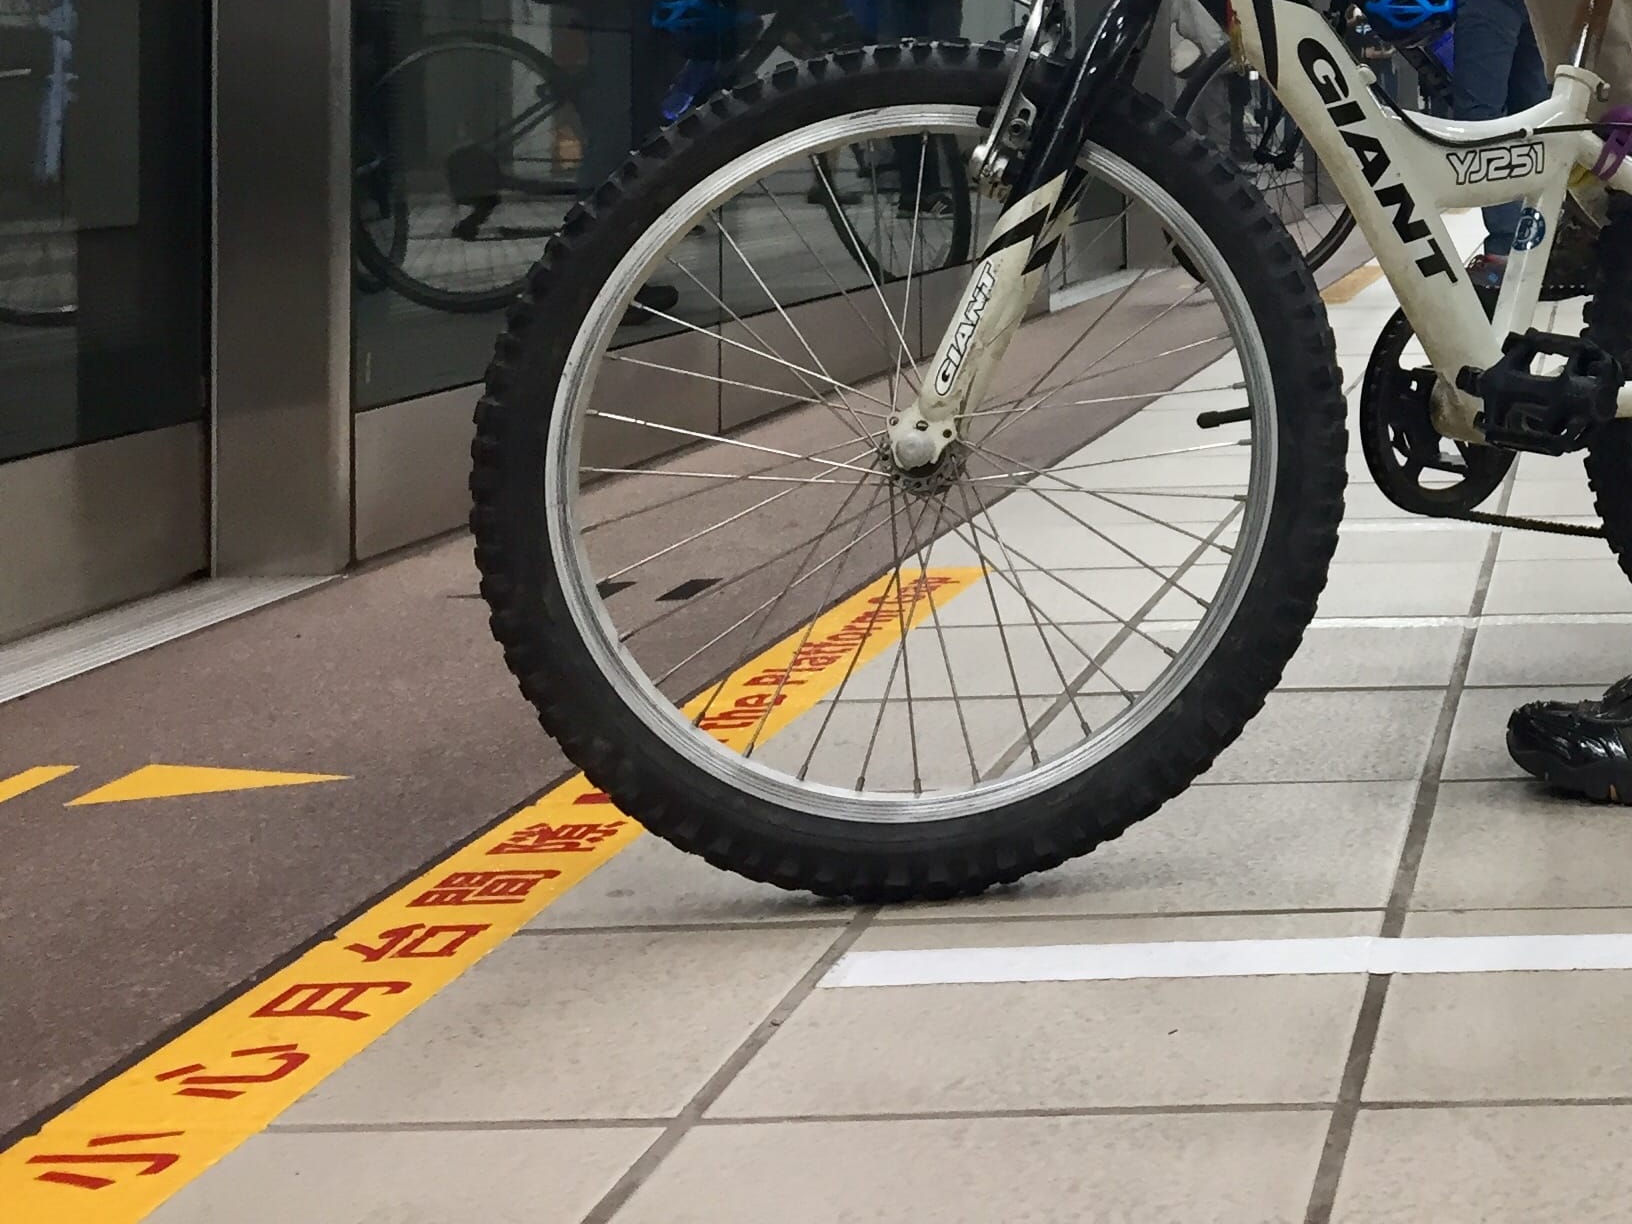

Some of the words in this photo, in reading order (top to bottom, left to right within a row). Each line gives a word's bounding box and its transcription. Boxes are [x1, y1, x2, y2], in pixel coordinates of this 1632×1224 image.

[1297, 36, 1459, 285] GIANT
[1446, 141, 1545, 186] YJ251
[933, 261, 998, 397] GIANT
[28, 814, 626, 1189] 小心月台間隙
